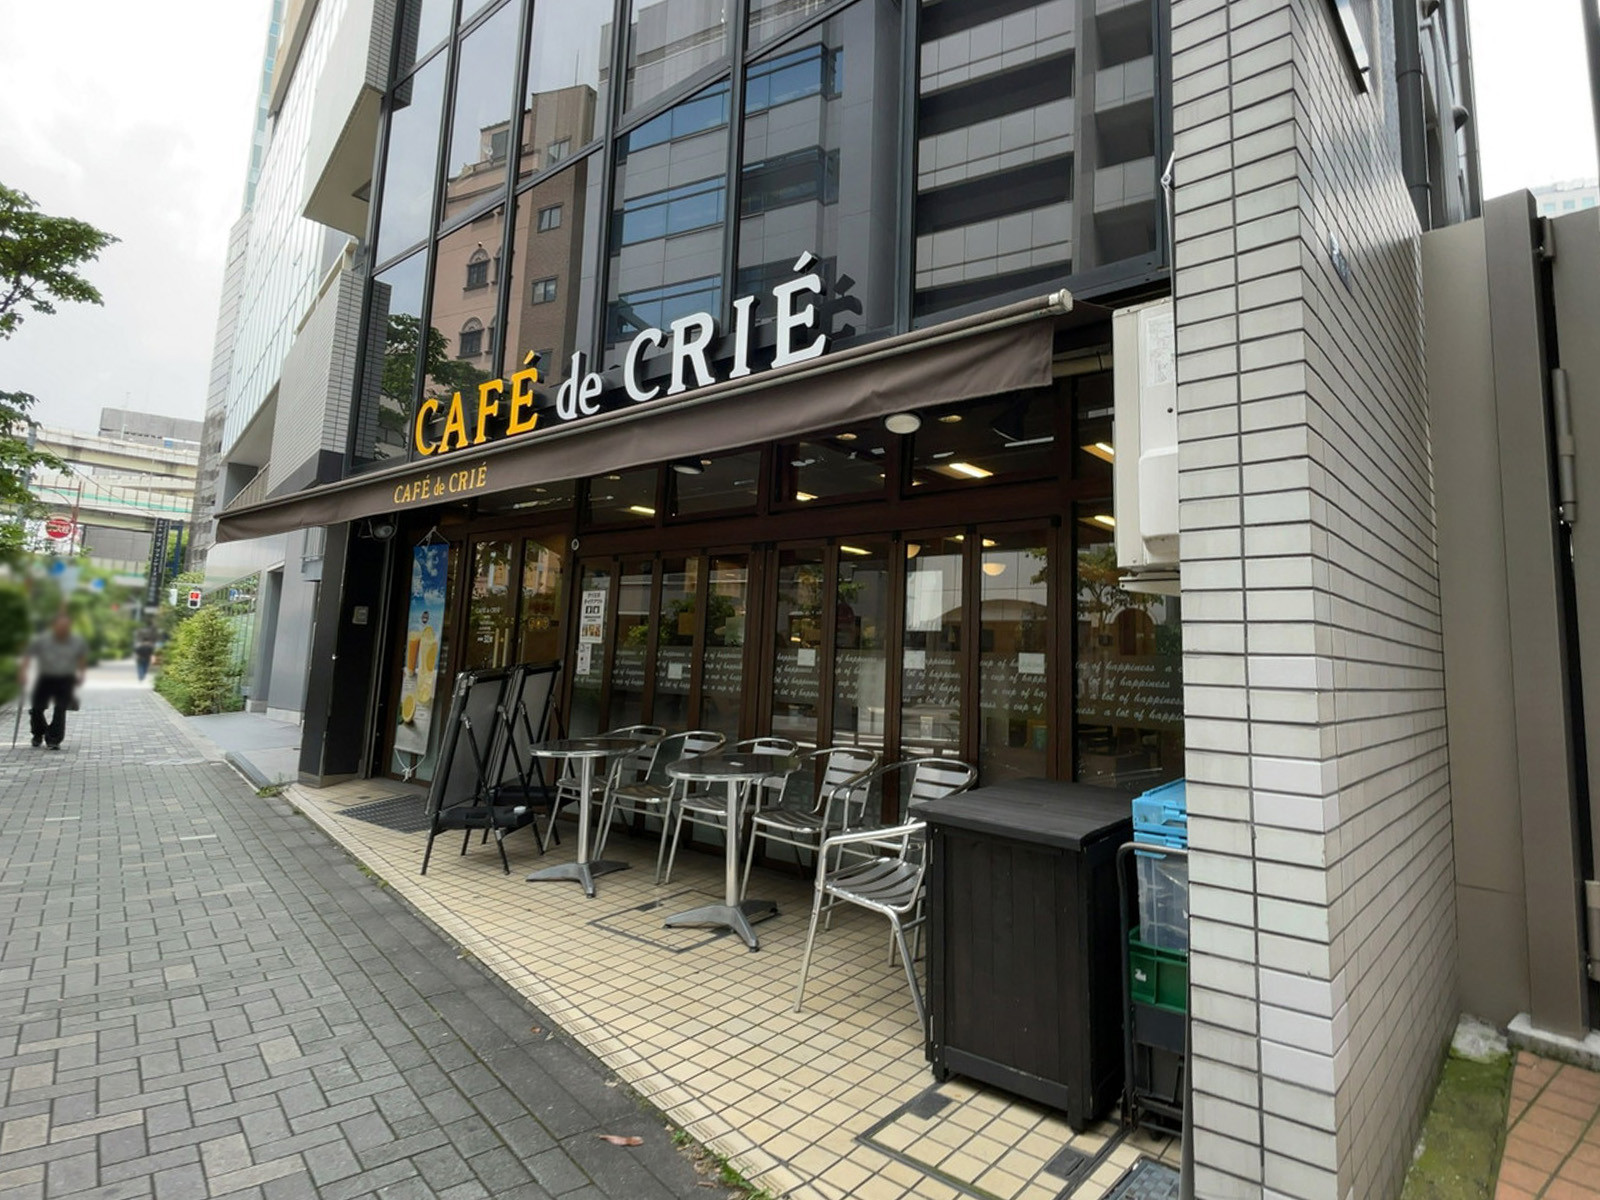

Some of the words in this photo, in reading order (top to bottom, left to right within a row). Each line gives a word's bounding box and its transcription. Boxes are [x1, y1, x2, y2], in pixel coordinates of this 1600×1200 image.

[415, 350, 540, 456] CAFÉ
[556, 351, 602, 421] de
[624, 251, 827, 402] CRIÉ
[393, 468, 431, 503] CAFÉ
[433, 480, 446, 496] de
[448, 462, 488, 493] CRIÉ
[1105, 660, 1156, 673] happiness
[1119, 676, 1170, 690] happiness
